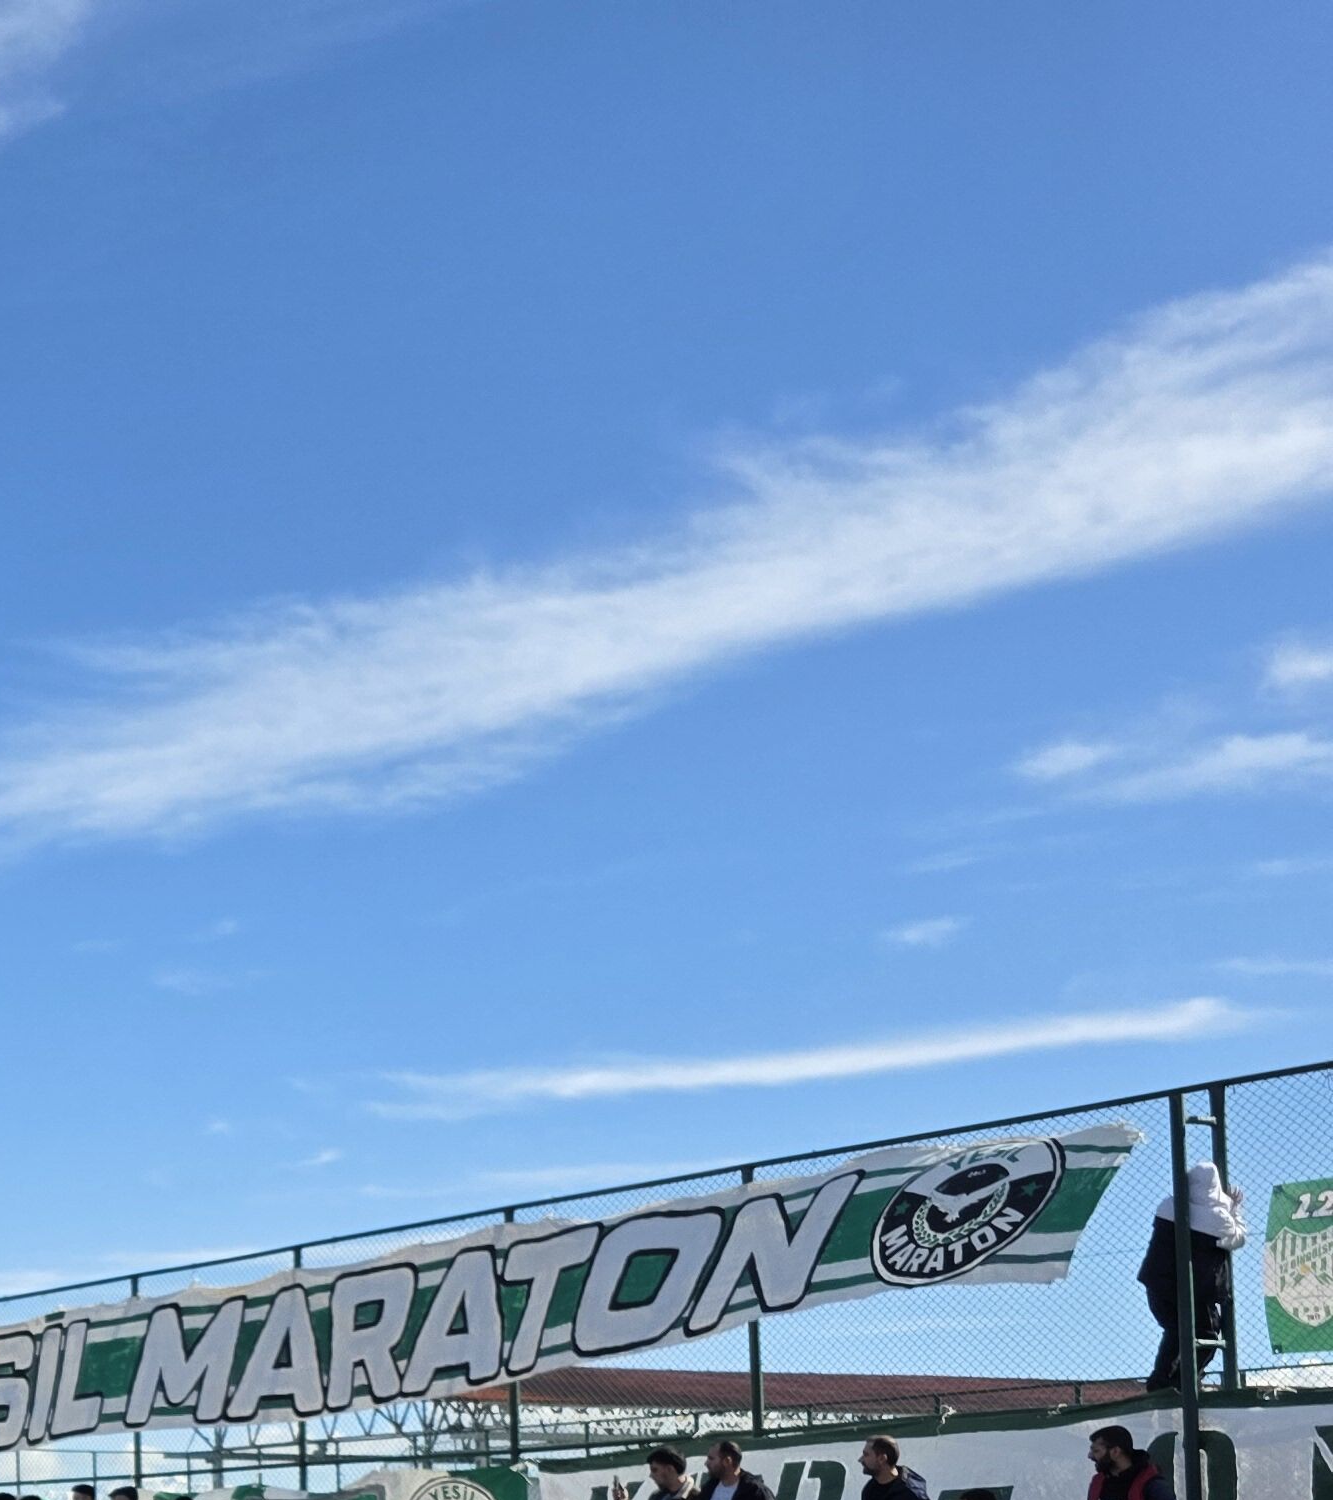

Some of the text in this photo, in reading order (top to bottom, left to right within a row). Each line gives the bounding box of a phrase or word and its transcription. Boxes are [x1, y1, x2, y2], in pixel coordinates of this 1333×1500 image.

[1291, 1189, 1333, 1220] 12
[881, 1206, 1025, 1274] MARATON
[122, 1168, 867, 1428] MARATON
